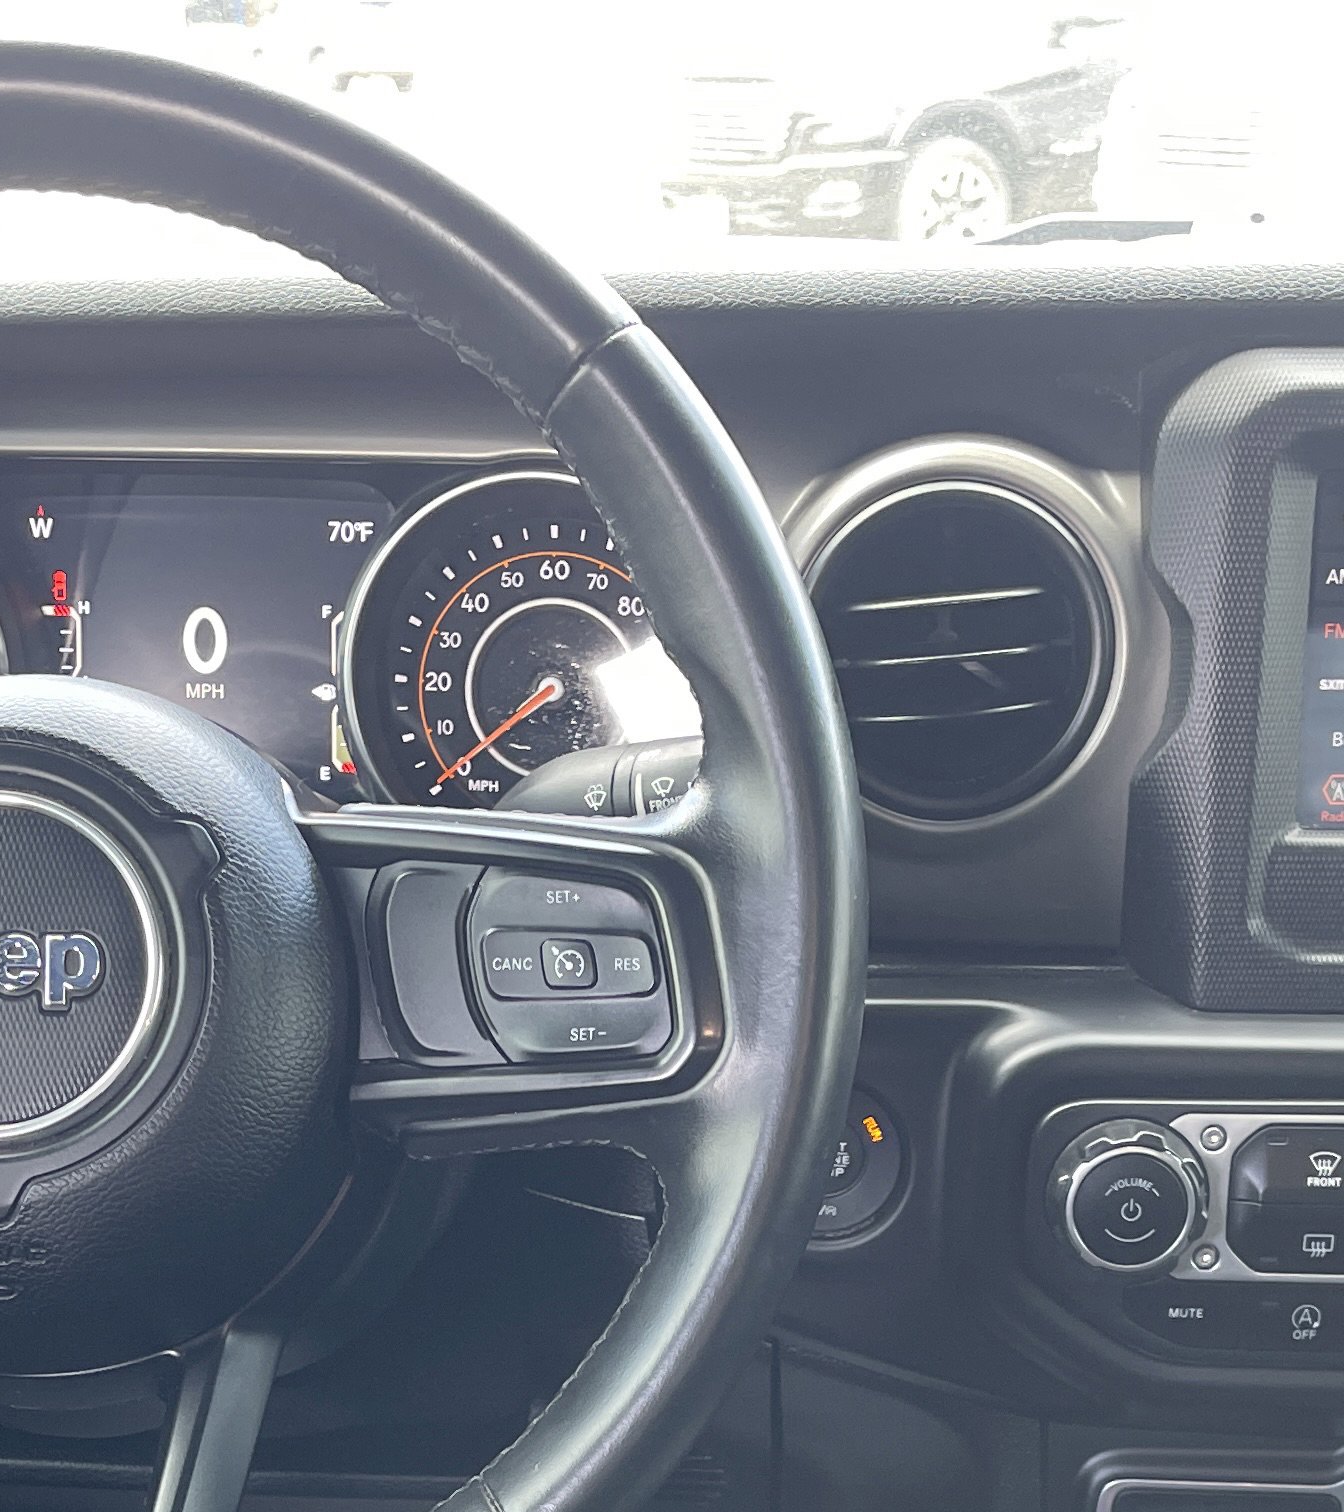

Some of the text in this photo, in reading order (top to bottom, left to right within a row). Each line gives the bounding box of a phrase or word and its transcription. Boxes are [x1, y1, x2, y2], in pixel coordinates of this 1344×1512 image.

[28, 517, 54, 539] W
[327, 520, 375, 543] 70°F
[539, 559, 571, 581] 60
[500, 571, 525, 588] 50
[586, 573, 609, 590] 70
[78, 601, 91, 616] H
[460, 592, 491, 613] 40
[617, 595, 646, 617] 80
[321, 604, 332, 619] F
[183, 606, 229, 675] 0
[438, 632, 462, 650] 30
[425, 671, 453, 693] 20
[186, 683, 225, 700] MPH
[436, 718, 454, 737] 10
[320, 766, 331, 782] E
[468, 778, 500, 793] MPH
[649, 795, 684, 813] FRO
[492, 957, 534, 971] CANC
[614, 957, 641, 972] RES
[1110, 1177, 1154, 1192] VOLUME
[1306, 1176, 1343, 1189] FRONT
[1167, 1306, 1204, 1320] MUTE
[1292, 1328, 1318, 1341] OFF
